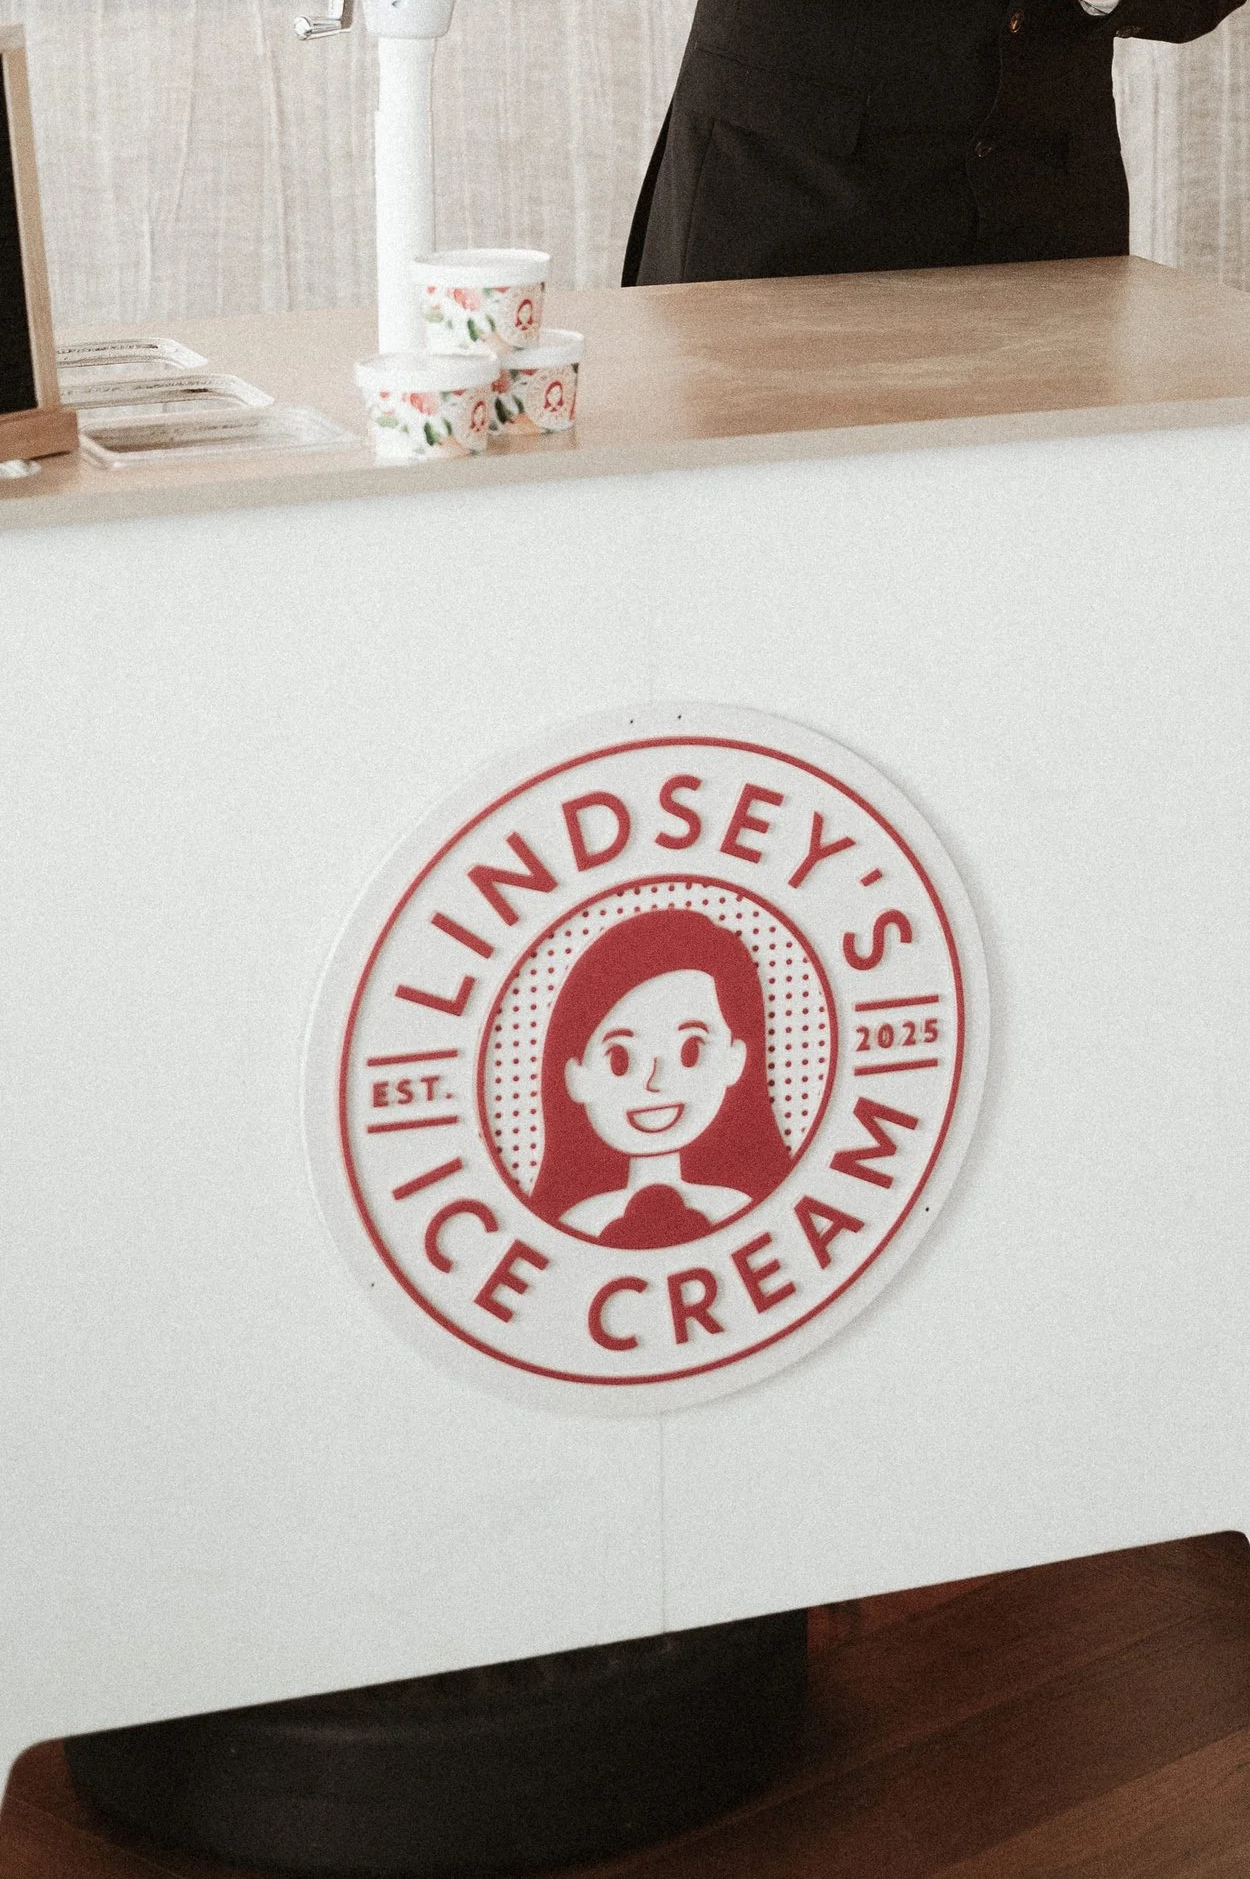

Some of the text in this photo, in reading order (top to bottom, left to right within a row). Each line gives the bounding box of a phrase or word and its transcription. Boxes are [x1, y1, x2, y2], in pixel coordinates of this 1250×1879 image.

[393, 773, 914, 1018] LINDSEY'S
[370, 1074, 455, 1109] EST.
[855, 1017, 941, 1053] 2025
[391, 1096, 920, 1353] ICE CREAM
